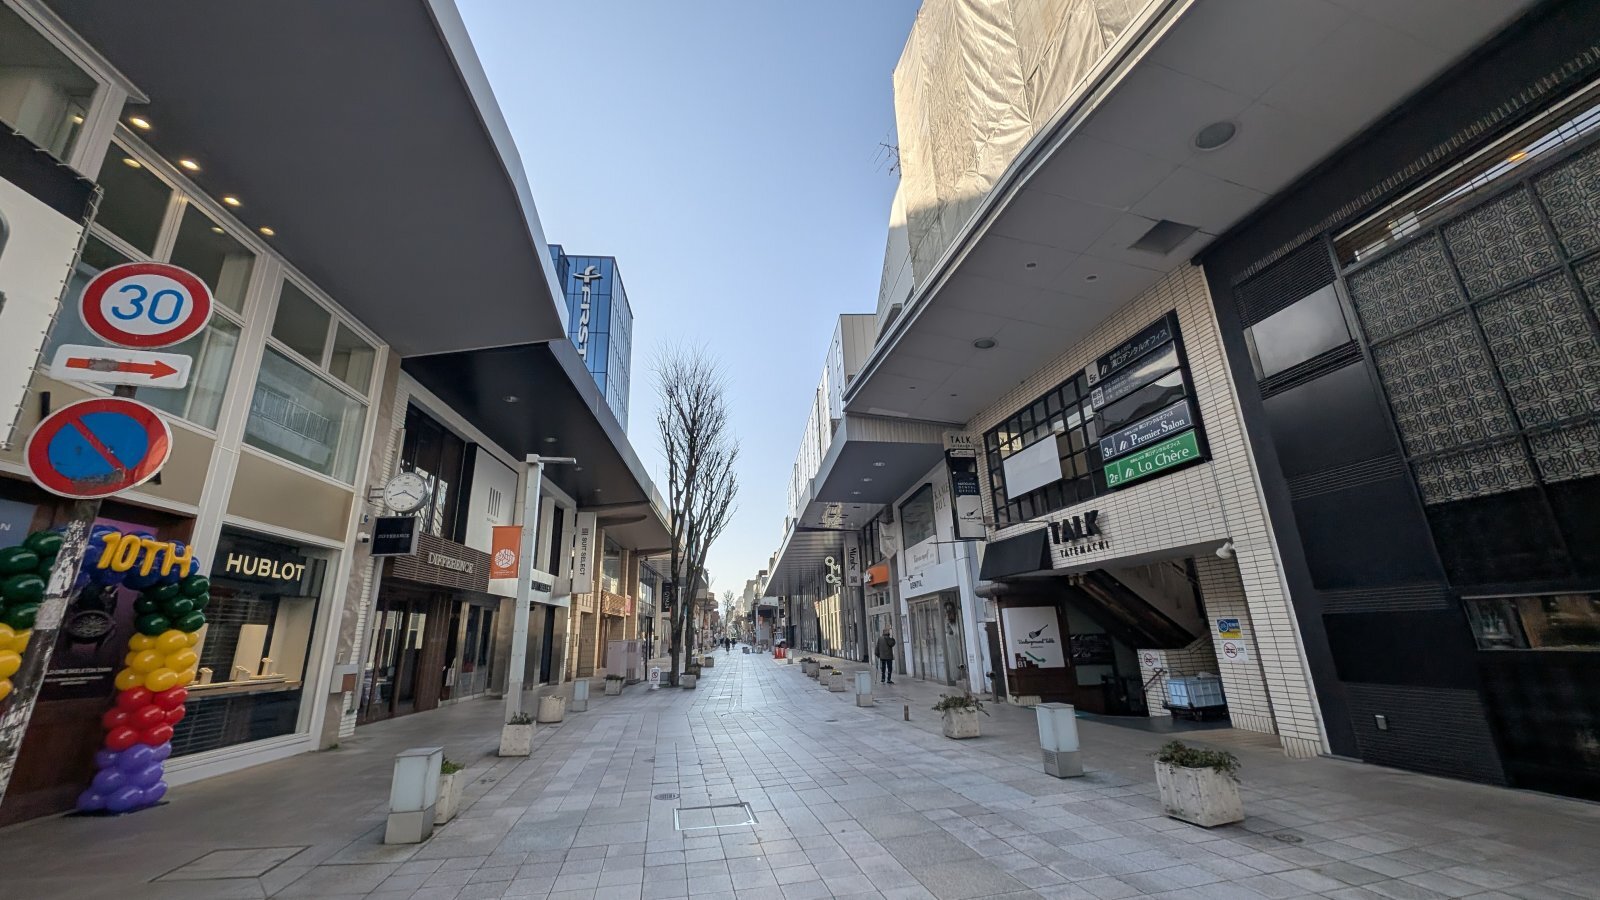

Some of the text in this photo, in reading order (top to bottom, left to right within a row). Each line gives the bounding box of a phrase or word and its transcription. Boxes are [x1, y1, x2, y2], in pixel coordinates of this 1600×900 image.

[111, 284, 184, 325] 30
[1089, 373, 1097, 384] 5F
[950, 436, 972, 444] TALK
[1130, 429, 1161, 446] Premier
[1160, 419, 1185, 433] Salon
[1104, 447, 1113, 457] 3F
[1138, 461, 1153, 473] La
[1154, 448, 1190, 466] Chère
[1109, 473, 1119, 484] 2F
[1047, 510, 1102, 545] TALK
[96, 531, 193, 578] 10TH
[1060, 540, 1110, 558] TATEMACHI
[225, 552, 306, 582] HUBLOT
[427, 551, 474, 574] DIFFERENCE
[579, 551, 587, 576] SELECT
[1017, 660, 1027, 668] B1
